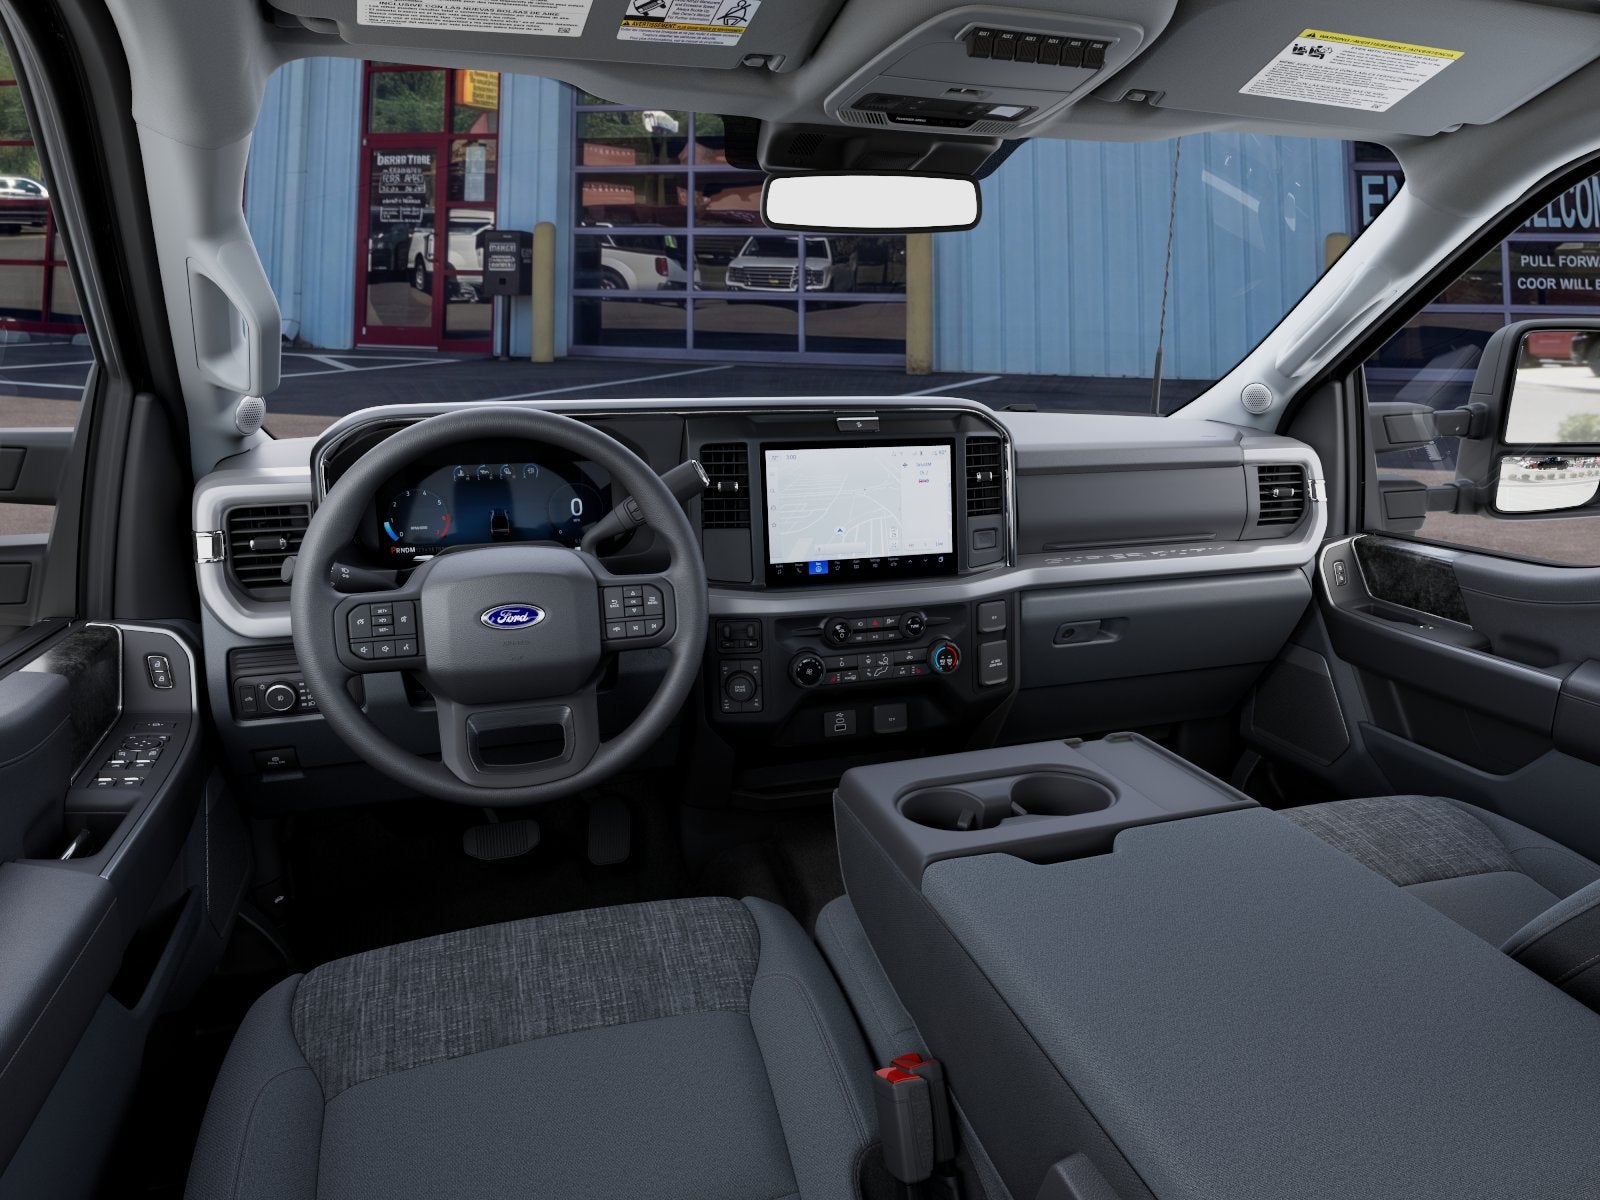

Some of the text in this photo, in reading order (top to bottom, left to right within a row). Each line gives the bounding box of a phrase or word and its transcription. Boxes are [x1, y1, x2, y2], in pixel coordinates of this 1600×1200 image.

[1520, 255, 1600, 268] PULL FORW
[1517, 277, 1557, 290] COOR
[1559, 278, 1593, 290] WILL
[570, 497, 583, 516] 0
[496, 609, 530, 624] Ford
